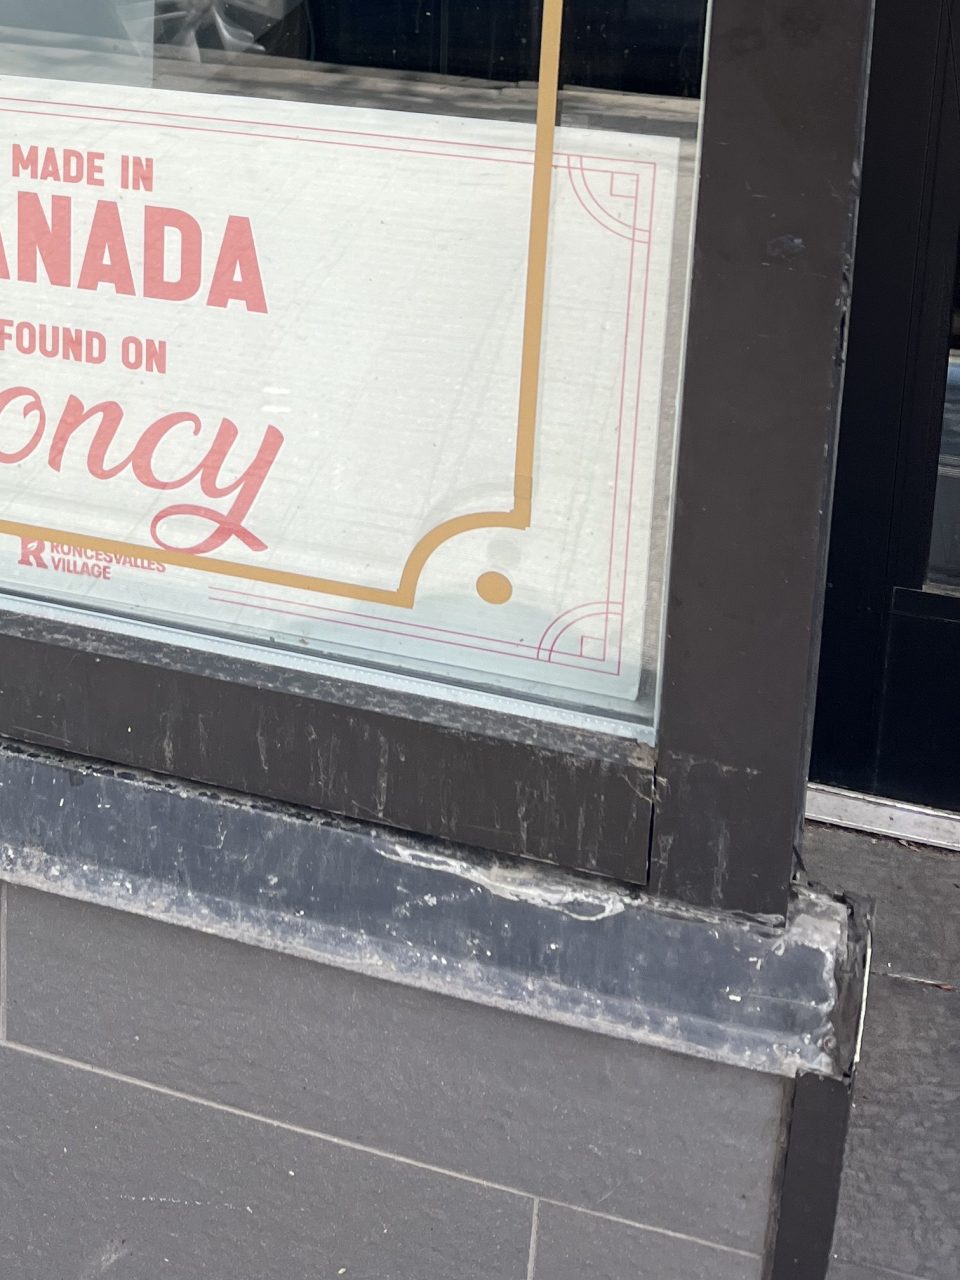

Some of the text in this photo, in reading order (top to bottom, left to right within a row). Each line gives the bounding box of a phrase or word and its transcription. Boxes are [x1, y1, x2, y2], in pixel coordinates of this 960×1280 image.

[11, 143, 154, 192] MADE IN
[121, 335, 167, 375] ON
[51, 556, 111, 580] VILLAGE
